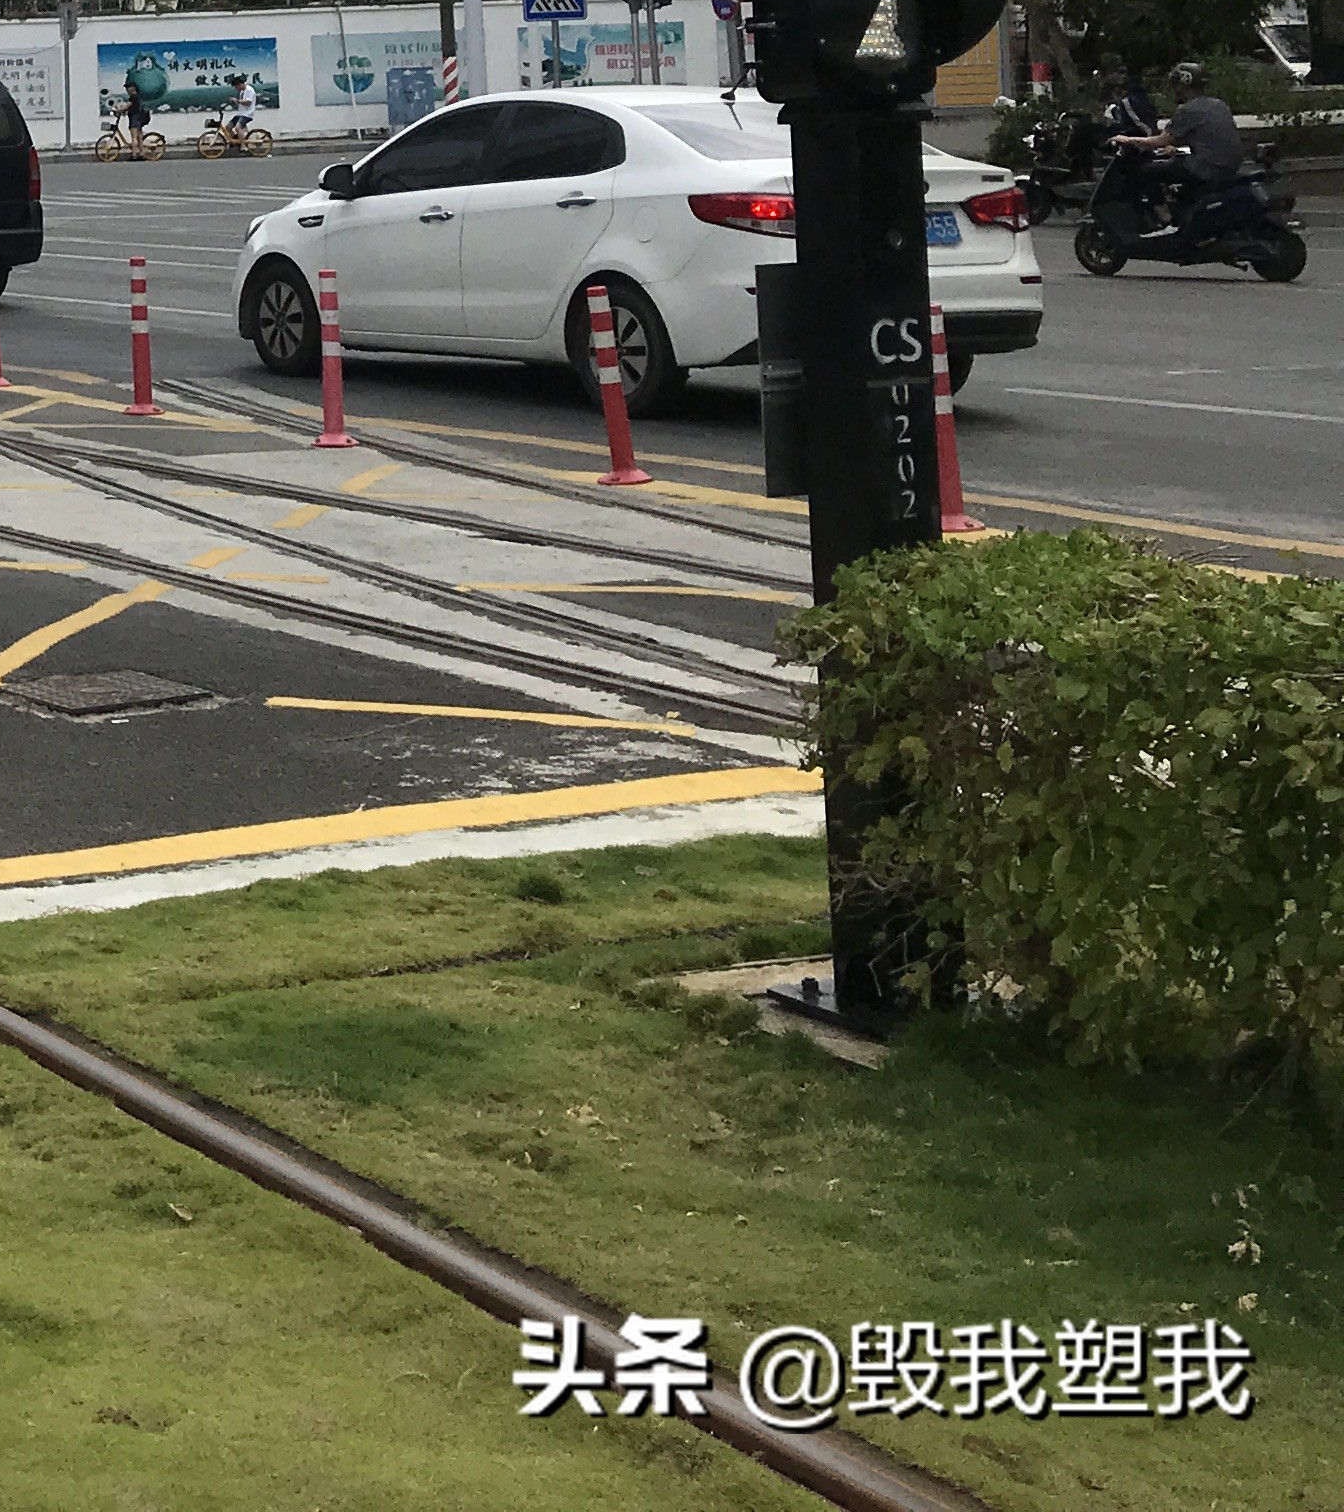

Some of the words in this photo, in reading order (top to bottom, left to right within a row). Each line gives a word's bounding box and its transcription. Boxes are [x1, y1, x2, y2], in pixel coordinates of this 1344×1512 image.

[167, 58, 236, 72] 讲文明礼仪
[870, 318, 923, 365] CS
